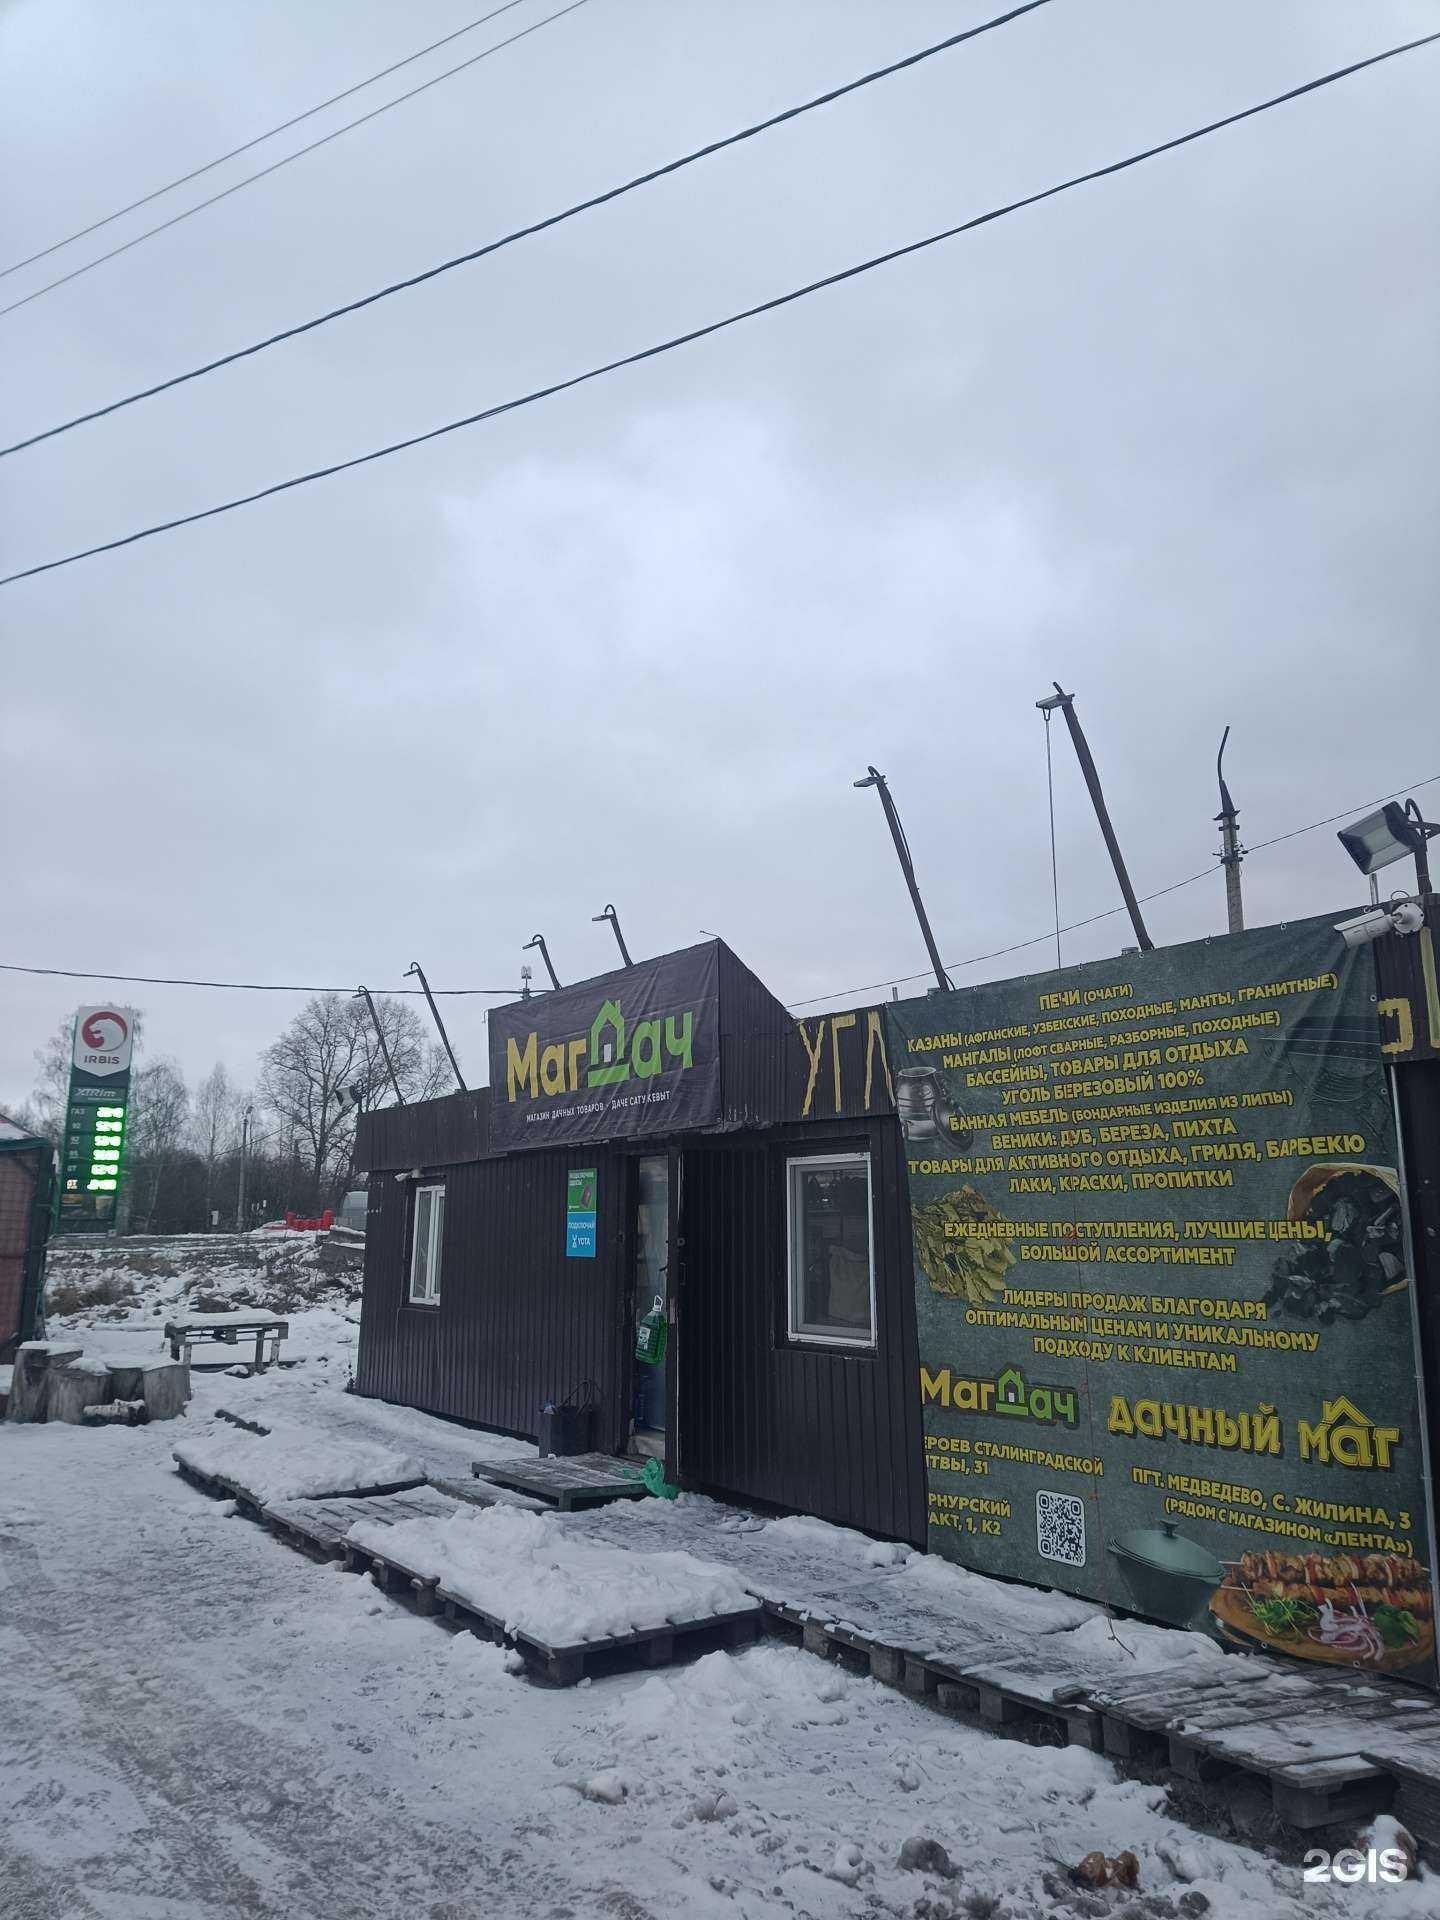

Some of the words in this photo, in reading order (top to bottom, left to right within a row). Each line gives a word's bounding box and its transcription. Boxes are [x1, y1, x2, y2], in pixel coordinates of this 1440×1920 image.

[907, 1032, 962, 1053] КАЗАНЫ
[964, 1024, 1031, 1047] (АФГАНСКИЕ,
[1032, 1013, 1100, 1035] УЗБЕКСКИЕ,
[1101, 1001, 1177, 1024] ПОХОДНЫЕ,
[1180, 992, 1235, 1011] МАНТЫ,
[1238, 972, 1339, 1002] ГРАНИТНЫЕ)
[1039, 989, 1081, 1011] ПЕЧИ
[1083, 984, 1134, 1006] (ОЧАГИ)
[943, 1047, 1011, 1069] МАНГАЛЫ
[1013, 1045, 1048, 1062] (ЛОФТ
[1050, 1036, 1107, 1056] СВАРНЫЕ,
[1109, 1024, 1190, 1047] РАЗБОРНЫЕ,
[1192, 1010, 1281, 1036] ПОХОДНЫЕ)
[84, 1055, 120, 1065] IRBIS
[966, 1063, 1048, 1088] БАССЕЙНЫ,
[1050, 1054, 1119, 1077] ТОВАРЫ
[1122, 1050, 1162, 1072] ДЛЯ
[1165, 1037, 1249, 1063] ОТДЫХА
[1001, 1087, 1051, 1106] УГОЛЬ
[1053, 1071, 1154, 1101] БЕРЕЗОВЫЙ
[1157, 1068, 1206, 1090] 100%
[526, 1111, 550, 1123] МАГАЗИН
[551, 1107, 575, 1120] ДАЧНЫХ
[576, 1102, 605, 1116] ТОВАРОВ
[629, 1094, 646, 1107] САТУ
[949, 1113, 1006, 1132] БАННАЯ
[1010, 1107, 1069, 1127] МЕБЕЛЬ
[1072, 1101, 1152, 1124] (БОНДАРНЫЕ
[1154, 1097, 1217, 1116] ИЗДЕЛИЯ
[1219, 1094, 1238, 1109] ИЗ
[1240, 1089, 1294, 1108] ЛИПЫ)
[991, 1131, 1057, 1150] ВЕНИКИ:
[1060, 1129, 1097, 1147] ДУБ,
[1099, 1124, 1170, 1143] БЕРЕЗА,
[1172, 1117, 1238, 1138] ПИХТА
[908, 1159, 973, 1175] ТОВАРЫ
[975, 1158, 1005, 1174] ДЛЯ
[1008, 1151, 1103, 1171] АКТИВНОГО
[1106, 1146, 1188, 1167] ОТДЫХА,
[1190, 1142, 1263, 1163] ГРИЛЯ,
[1266, 1134, 1366, 1158] БАРБЕКЮ
[1008, 1177, 1057, 1195] ЛАКИ,
[1060, 1173, 1129, 1193] КРАСКИ,
[1131, 1169, 1234, 1191] ПРОПИТКИ
[944, 1222, 1049, 1240] ЕЖЕДНЕВНЫЕ
[1051, 1221, 1180, 1241] ПОСТУПЛЕНИЯ,
[1183, 1221, 1266, 1240] ЛУЧШИЕ
[1268, 1221, 1333, 1243] ЦЕНЫ,
[1020, 1242, 1101, 1263] БОЛЬШОЙ
[1104, 1246, 1236, 1266] АССОРТИМЕНТ
[1002, 1288, 1069, 1309] ЛИДЕРЫ
[1071, 1292, 1149, 1314] ПРОДАЖ
[1151, 1297, 1268, 1321] БЛАГОДАРЯ
[964, 1310, 1087, 1333] ОПТИМАЛЬНЫМ
[1091, 1317, 1152, 1340] ЦЕНАМ
[1155, 1323, 1169, 1340] И
[1171, 1323, 1320, 1352] УНИКАЛЬНОМУ
[1033, 1336, 1114, 1361] ПОДХОДУ
[1117, 1344, 1133, 1362] К
[1133, 1346, 1238, 1373] КЛИЕНТАМ
[924, 1435, 971, 1453] РОЕВ
[974, 1440, 1105, 1477] СТАЛИНГРАДСКОЙ
[974, 1460, 990, 1475] 31
[1131, 1467, 1165, 1489] ПГТ.
[1167, 1476, 1269, 1509] МЕДВЕДЕВО,
[1272, 1496, 1291, 1513] С.
[1295, 1499, 1396, 1530] ЖИЛИНА,
[1399, 1511, 1412, 1531] 3
[982, 1519, 1002, 1536] К2
[1164, 1497, 1218, 1522] (РЯДОМ
[1218, 1507, 1228, 1523] С
[1228, 1511, 1321, 1543] МАГАЗИНОМ
[1323, 1526, 1414, 1558] «ЛЕНТА»)
